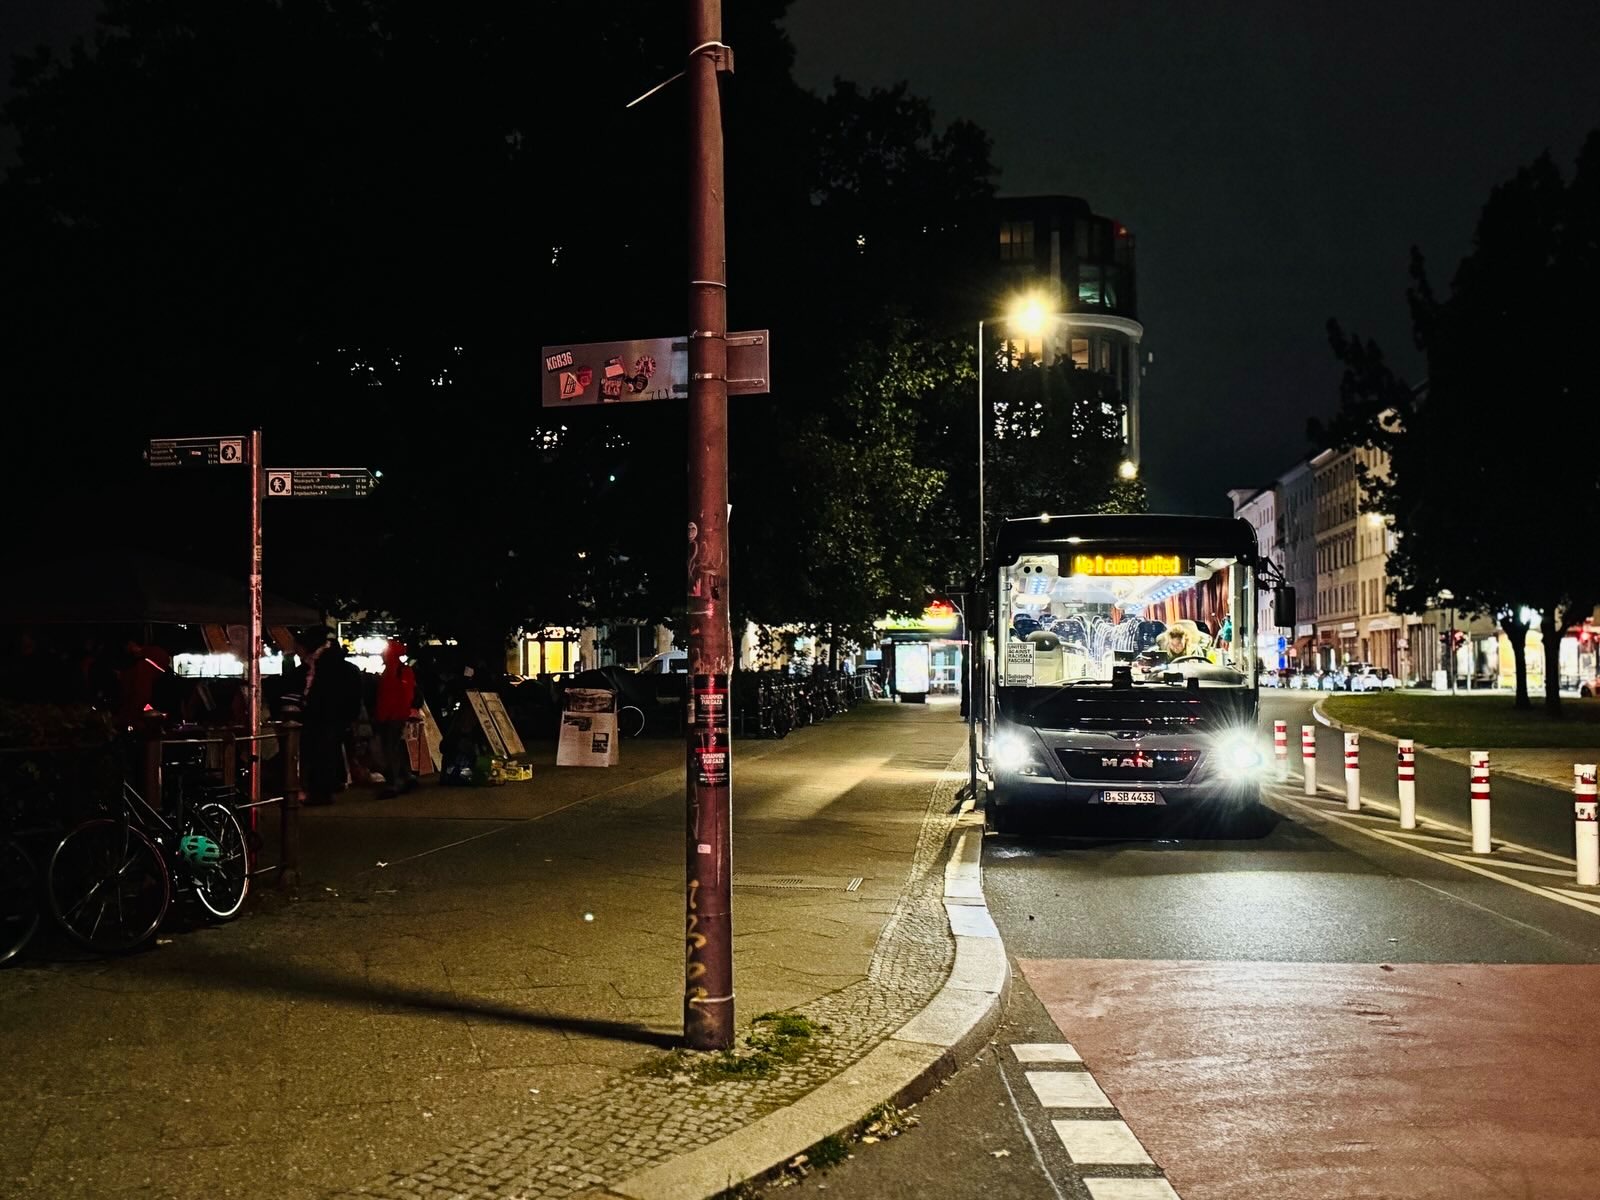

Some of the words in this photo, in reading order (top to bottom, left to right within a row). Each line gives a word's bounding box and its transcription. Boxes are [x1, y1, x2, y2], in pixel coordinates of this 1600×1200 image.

[1140, 555, 1180, 575] united
[1101, 758, 1153, 768] MAN
[1105, 792, 1112, 801] B
[1131, 792, 1154, 803] 4433
